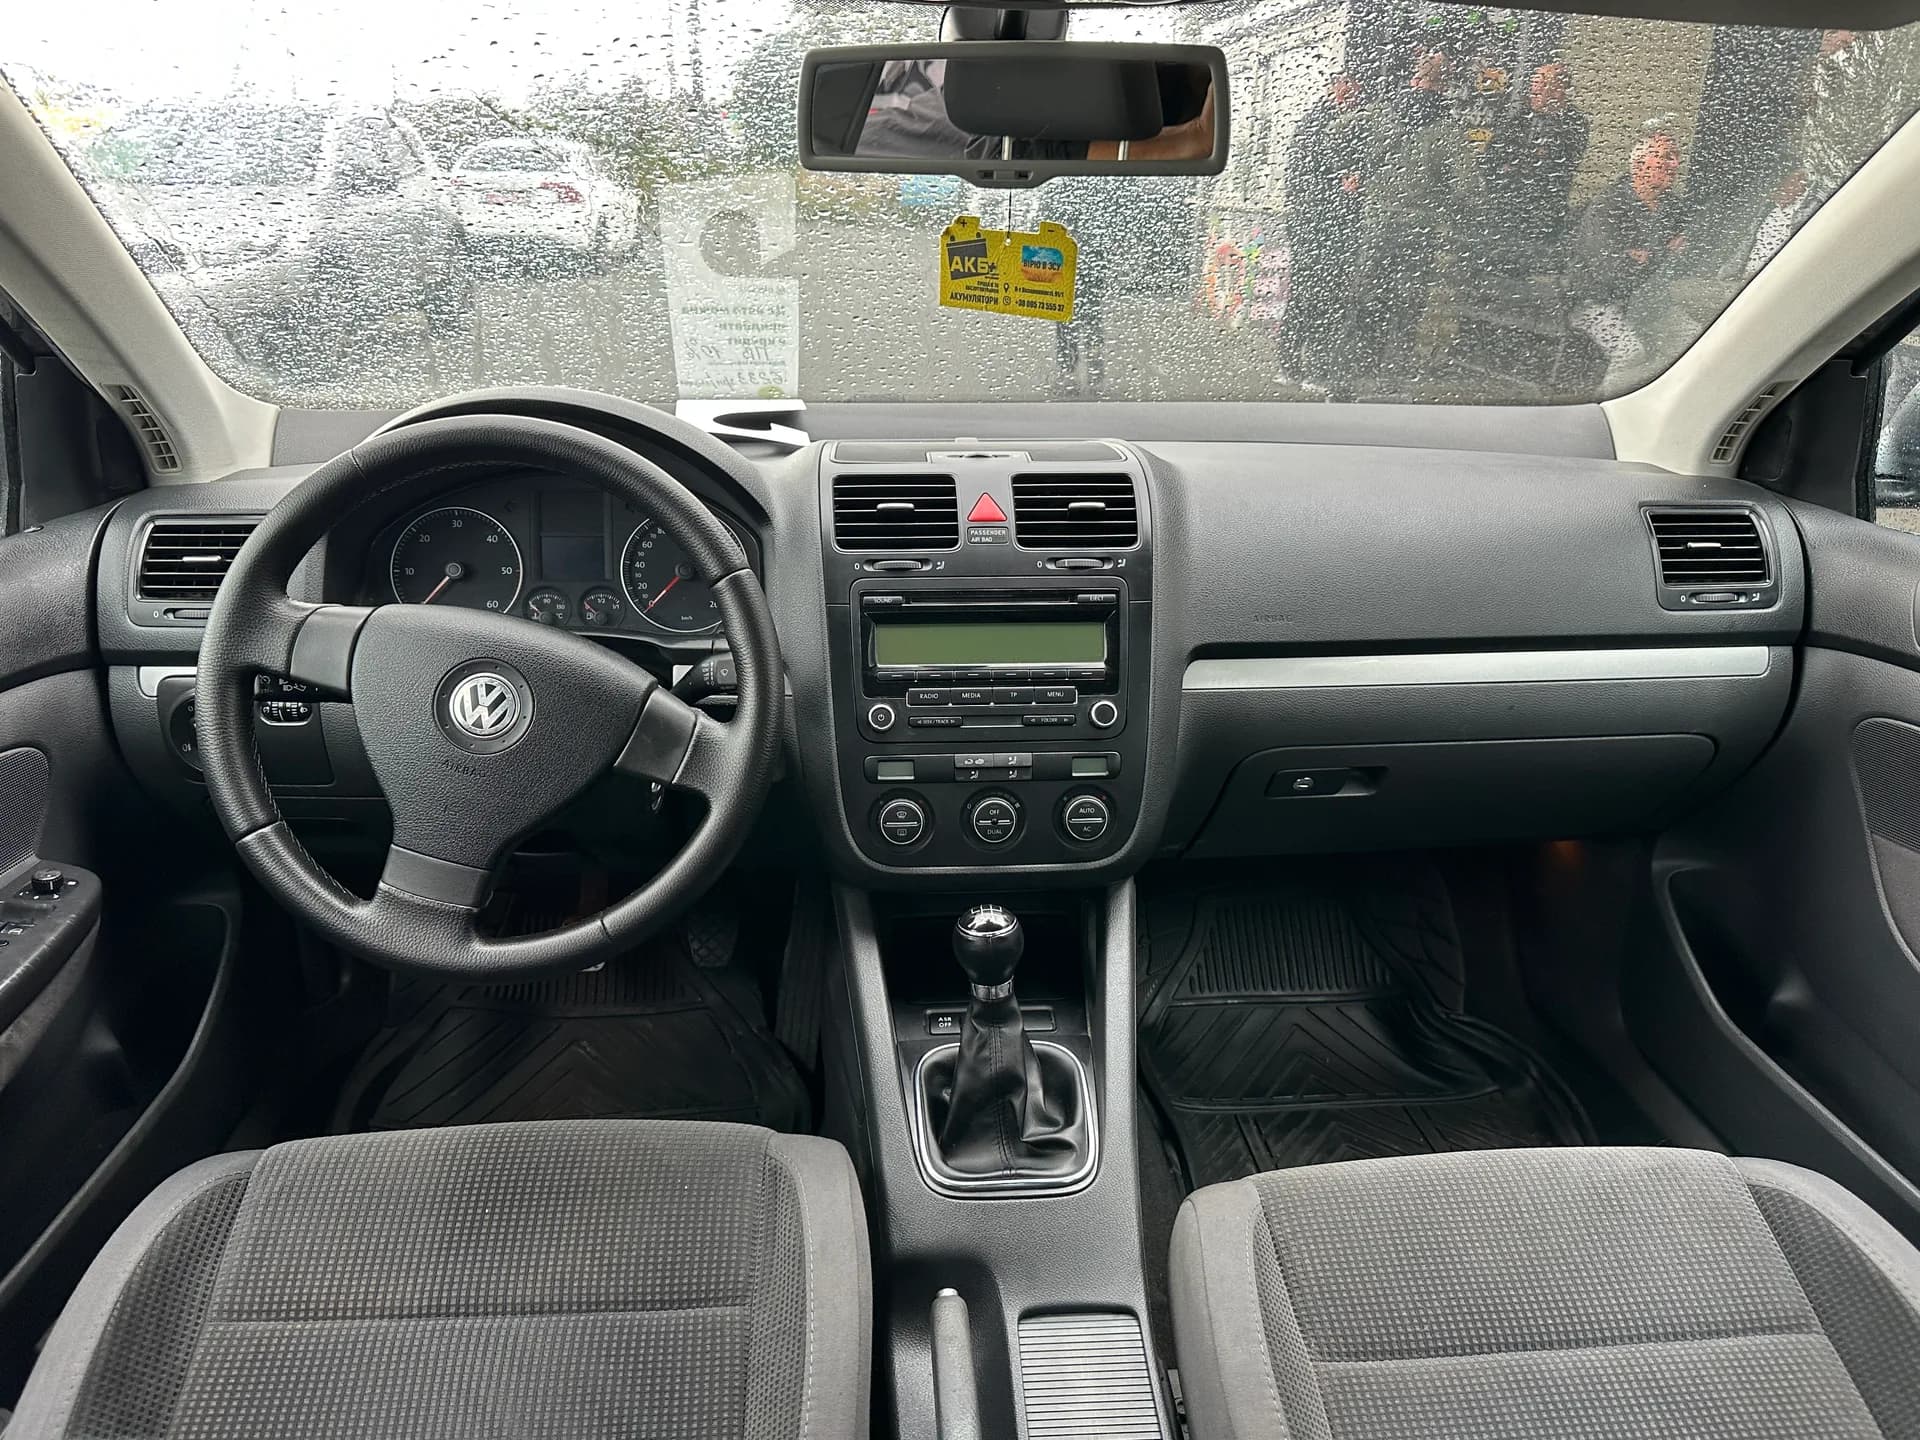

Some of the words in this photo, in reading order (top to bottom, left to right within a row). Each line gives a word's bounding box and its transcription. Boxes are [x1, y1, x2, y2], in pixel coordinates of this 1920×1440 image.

[1024, 260, 1042, 269] ВІРЮ
[1048, 262, 1062, 271] ЗСУ
[950, 292, 998, 305] АКУМУЛЯТОРИ
[451, 520, 463, 528] 30
[418, 534, 431, 543] 20
[486, 535, 498, 544] 40
[642, 541, 653, 549] 60
[634, 561, 646, 569] 40
[404, 568, 415, 576] 10
[501, 566, 513, 576] 50
[637, 582, 648, 590] 20
[486, 600, 499, 609] 60
